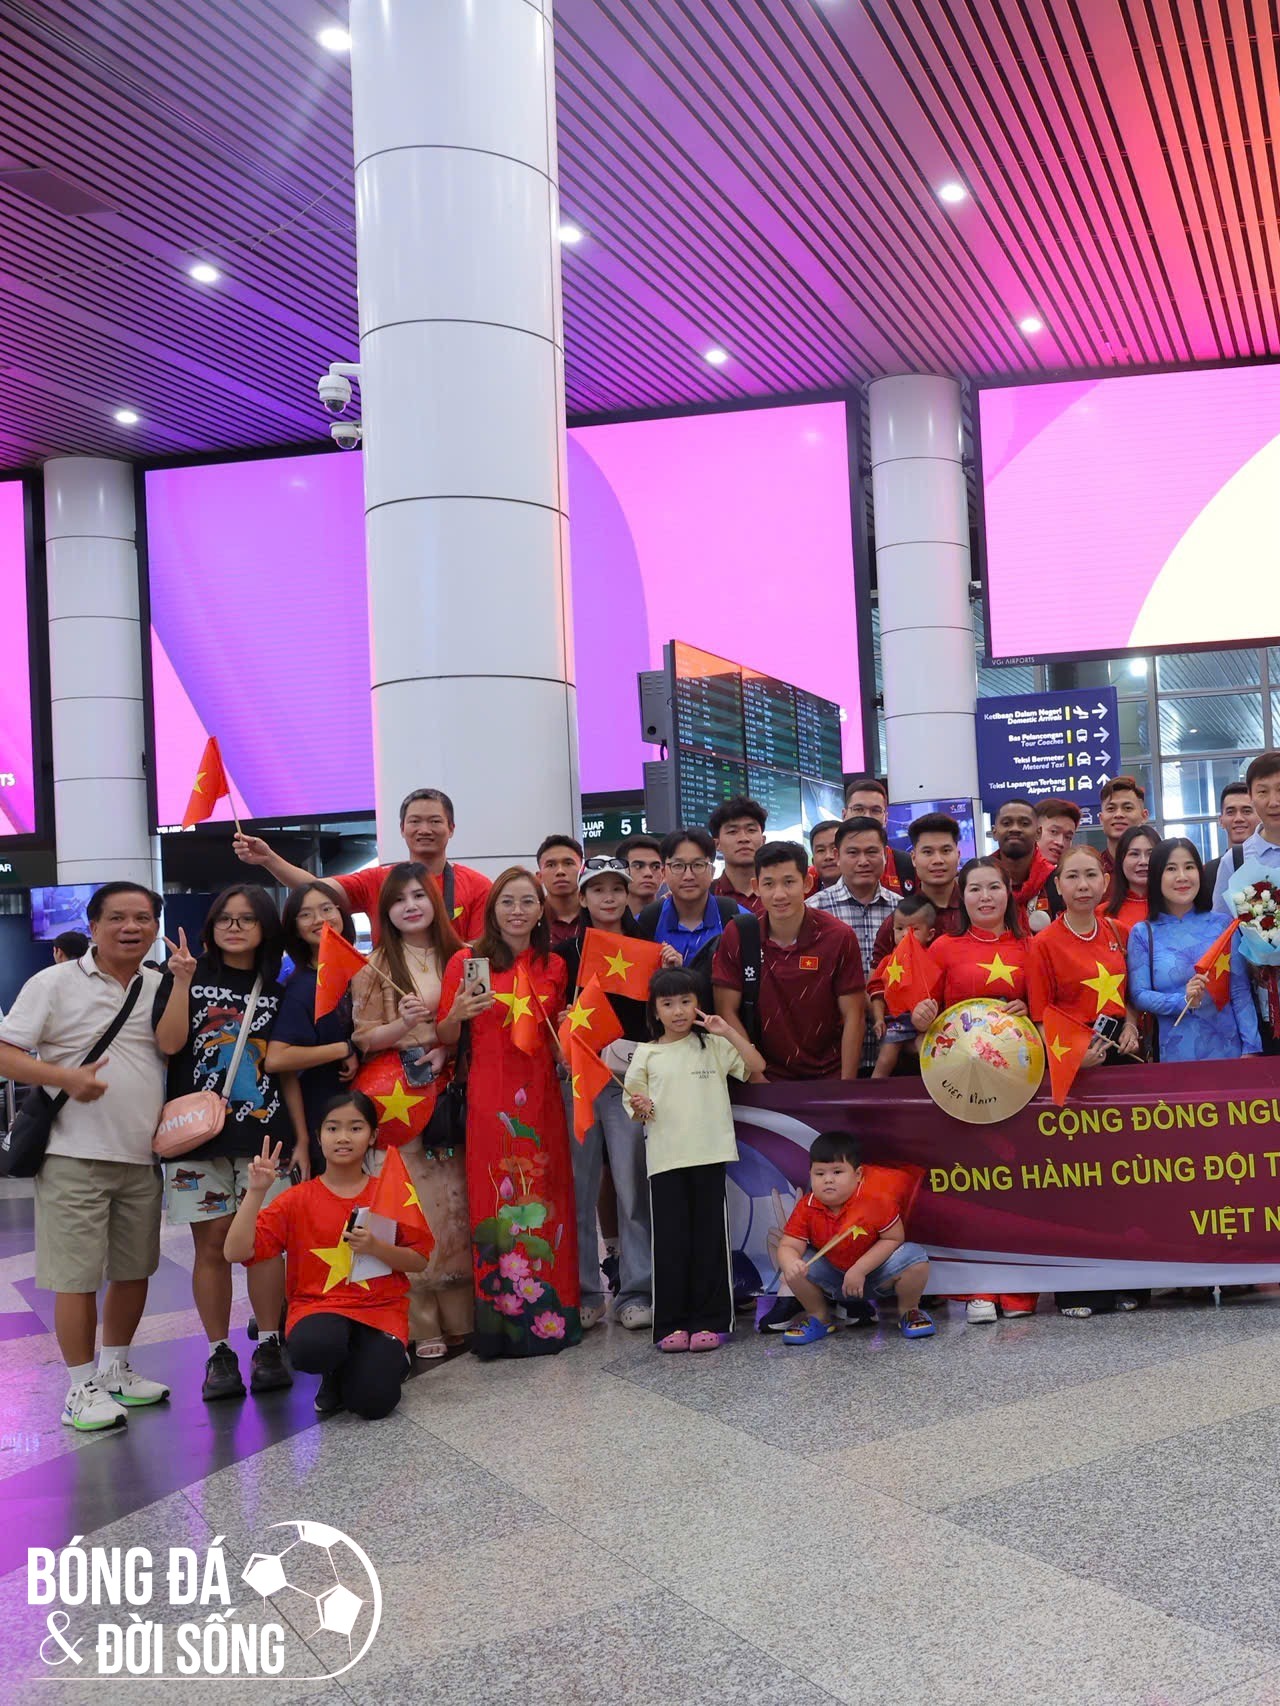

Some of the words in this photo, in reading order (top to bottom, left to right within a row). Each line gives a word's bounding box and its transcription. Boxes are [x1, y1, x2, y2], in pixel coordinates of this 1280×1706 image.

[1037, 738, 1064, 746] Coaches
[1022, 763, 1049, 771] Metered
[588, 830, 602, 838] OUT
[620, 818, 632, 836] 5
[1037, 1107, 1123, 1141] CỘNG
[1131, 1100, 1219, 1131] ĐỒNG
[929, 1161, 1013, 1193] ĐỒNG
[1021, 1157, 1103, 1189] HÀNH
[1112, 1153, 1196, 1186] CÙNG
[1203, 1151, 1256, 1185] ĐỘI
[1190, 1205, 1255, 1240] VIỆT
